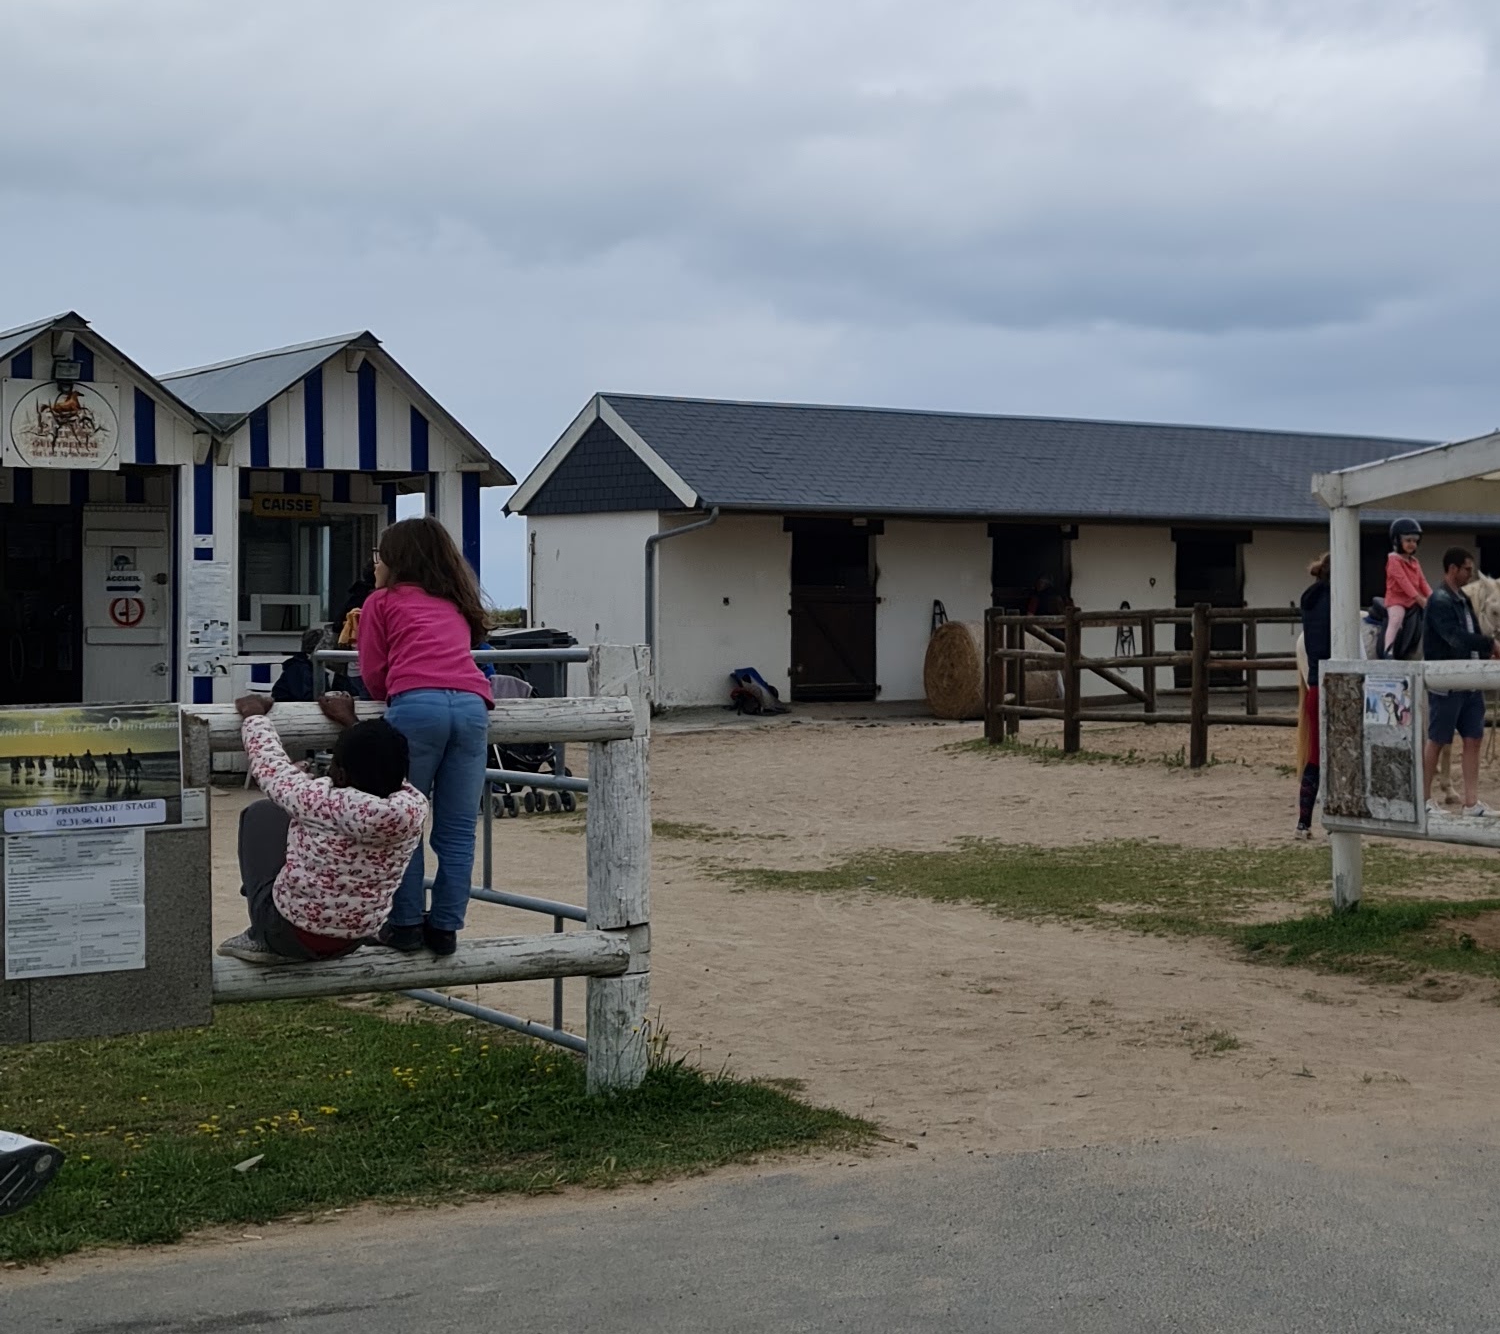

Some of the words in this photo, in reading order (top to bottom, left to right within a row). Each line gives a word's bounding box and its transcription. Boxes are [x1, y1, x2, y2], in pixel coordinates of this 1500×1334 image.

[261, 496, 313, 512] CAISSE
[106, 574, 142, 582] ACCUEIL
[13, 807, 49, 818] COURS
[56, 802, 119, 816] PROMENADE
[125, 800, 157, 811] STAGE
